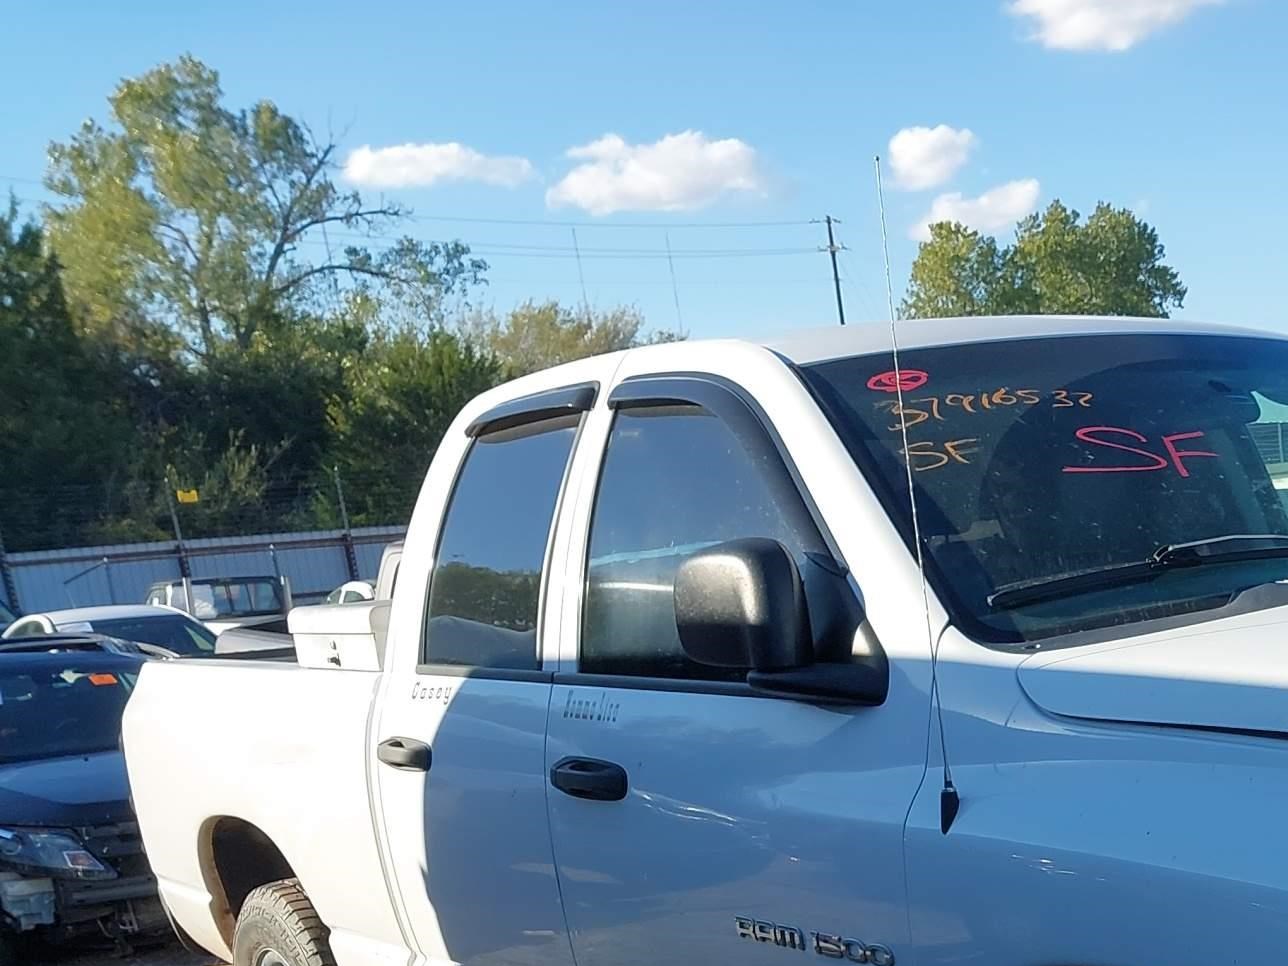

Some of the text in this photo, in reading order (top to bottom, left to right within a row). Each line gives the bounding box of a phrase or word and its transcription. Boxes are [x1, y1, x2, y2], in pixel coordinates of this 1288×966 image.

[899, 438, 983, 471] SF
[1062, 425, 1220, 478] SF
[734, 914, 807, 951] RAM
